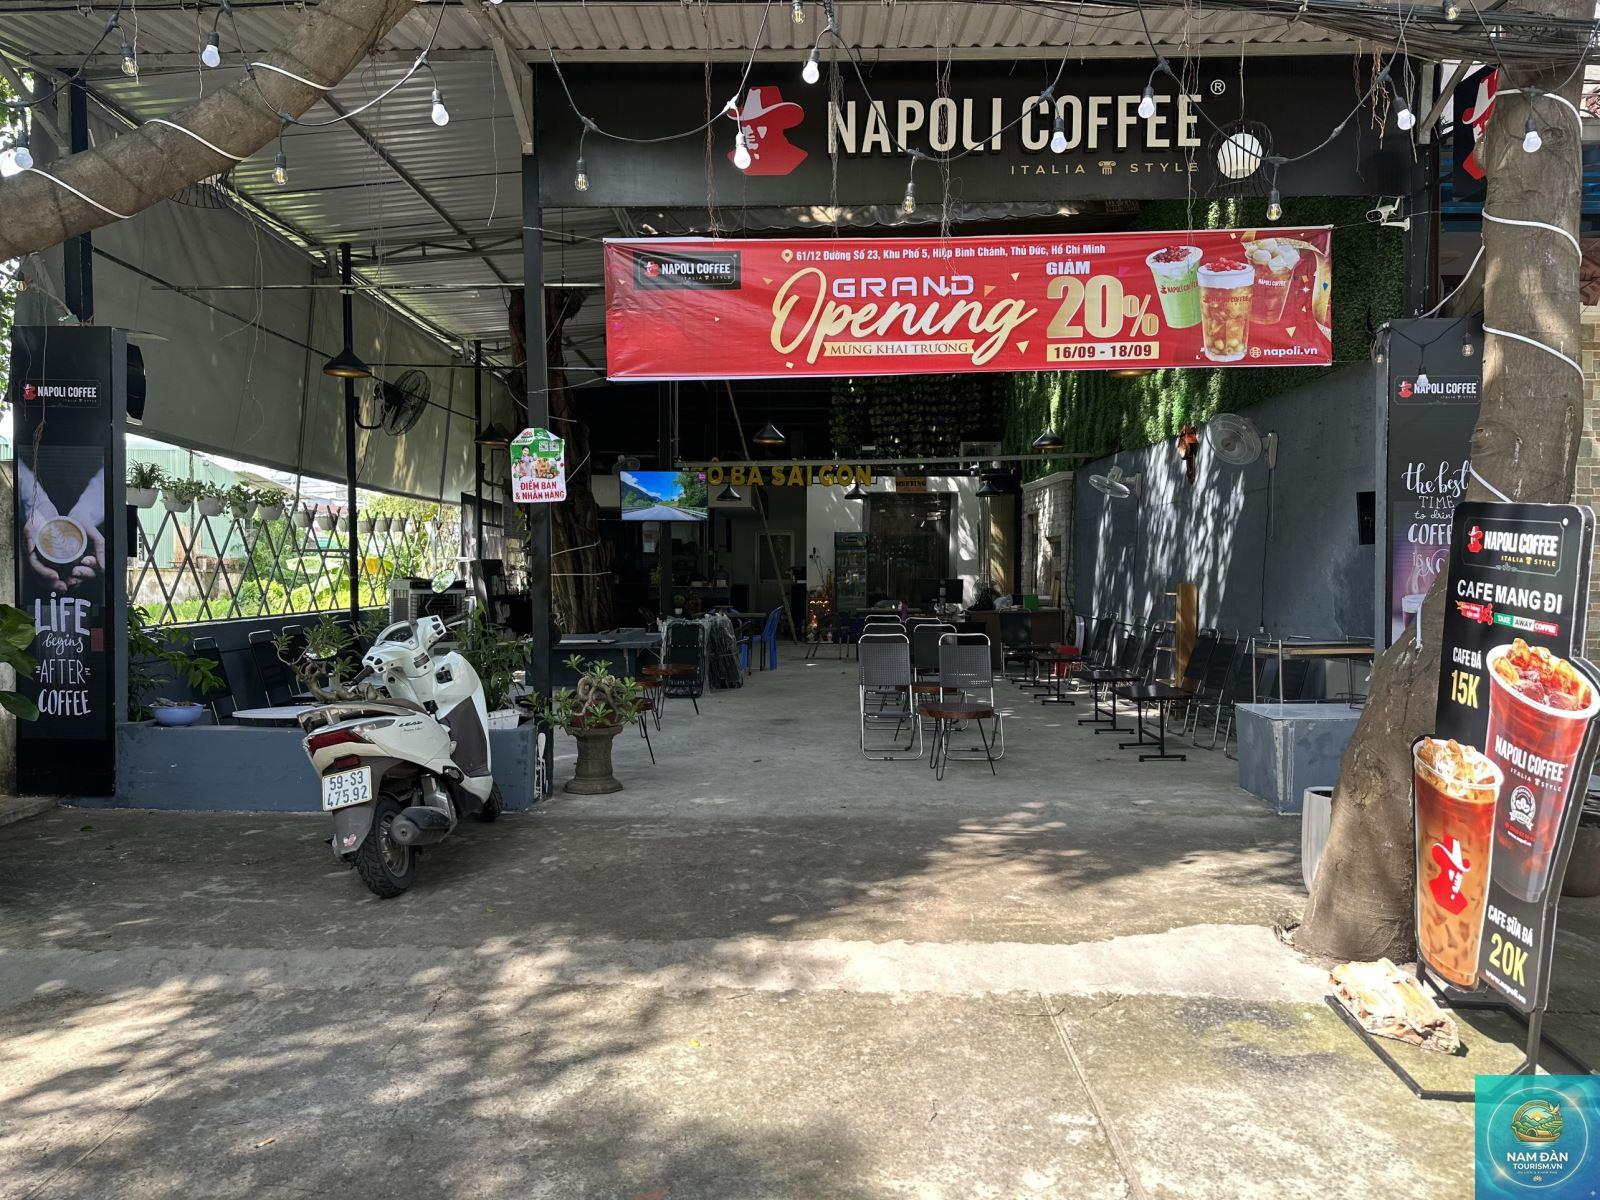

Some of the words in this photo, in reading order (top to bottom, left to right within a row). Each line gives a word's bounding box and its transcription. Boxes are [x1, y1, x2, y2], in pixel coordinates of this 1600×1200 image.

[828, 97, 1002, 155] NAPOLI
[1021, 94, 1202, 152] COFFEE
[1010, 164, 1086, 175] ITALIA
[1129, 162, 1199, 173] STYLE
[796, 250, 821, 261] 61/12
[853, 249, 865, 260] Số
[867, 250, 881, 260] 23,
[883, 250, 900, 259] Khu
[903, 248, 919, 259] Phố
[921, 249, 930, 259] 5,
[977, 246, 1008, 257] Chánh,
[1011, 245, 1026, 256] Thủ
[1029, 244, 1049, 256] Đức,
[1051, 244, 1063, 255] Hồ
[1066, 244, 1080, 255] Chí
[1083, 244, 1106, 254] Minh
[661, 263, 695, 275] NAPOLI
[696, 263, 731, 274] COFFEE
[1046, 258, 1091, 275] GIẢM
[832, 275, 974, 298] GRAND
[770, 267, 1038, 366] Opening
[1047, 275, 1159, 338] 20%
[877, 344, 908, 354] KHAI
[1054, 345, 1096, 359] 16/09
[1110, 344, 1152, 358] 18/09
[1263, 345, 1318, 358] napoli.vn
[37, 386, 66, 397] NAPOLI
[67, 386, 97, 398] COFFEE
[1413, 382, 1444, 394] NAPOLI
[1445, 382, 1477, 394] COFFEE
[1401, 462, 1435, 494] the
[1434, 460, 1470, 497] best
[1418, 495, 1455, 509] TIME
[1413, 510, 1427, 519] to
[1431, 509, 1454, 520] drin
[1484, 530, 1518, 553] NAPOLI
[1519, 533, 1559, 557] COFFEE
[1501, 555, 1524, 563] ITALIA
[1534, 558, 1556, 567] STYLE
[1457, 579, 1494, 602] CAFE
[1495, 585, 1541, 611] MANG
[1543, 592, 1563, 615] ĐI
[1514, 617, 1532, 628] AWAY
[41, 633, 84, 655] begins
[1452, 646, 1471, 667] CAFE
[1471, 649, 1482, 670] ĐÁ
[40, 659, 86, 684] AFTER
[1451, 669, 1481, 709] 15K
[38, 689, 91, 716] COFFEE
[1494, 734, 1528, 770] NAPOLI
[1527, 754, 1565, 783] COFFEE
[329, 770, 364, 791] 59-S3
[1510, 767, 1532, 782] ITALIA
[1540, 780, 1562, 792] STYLE
[327, 785, 368, 808] 475.92
[1487, 904, 1507, 930] CAFE
[1522, 925, 1534, 947] ĐÁ
[1489, 932, 1529, 987] 20K
